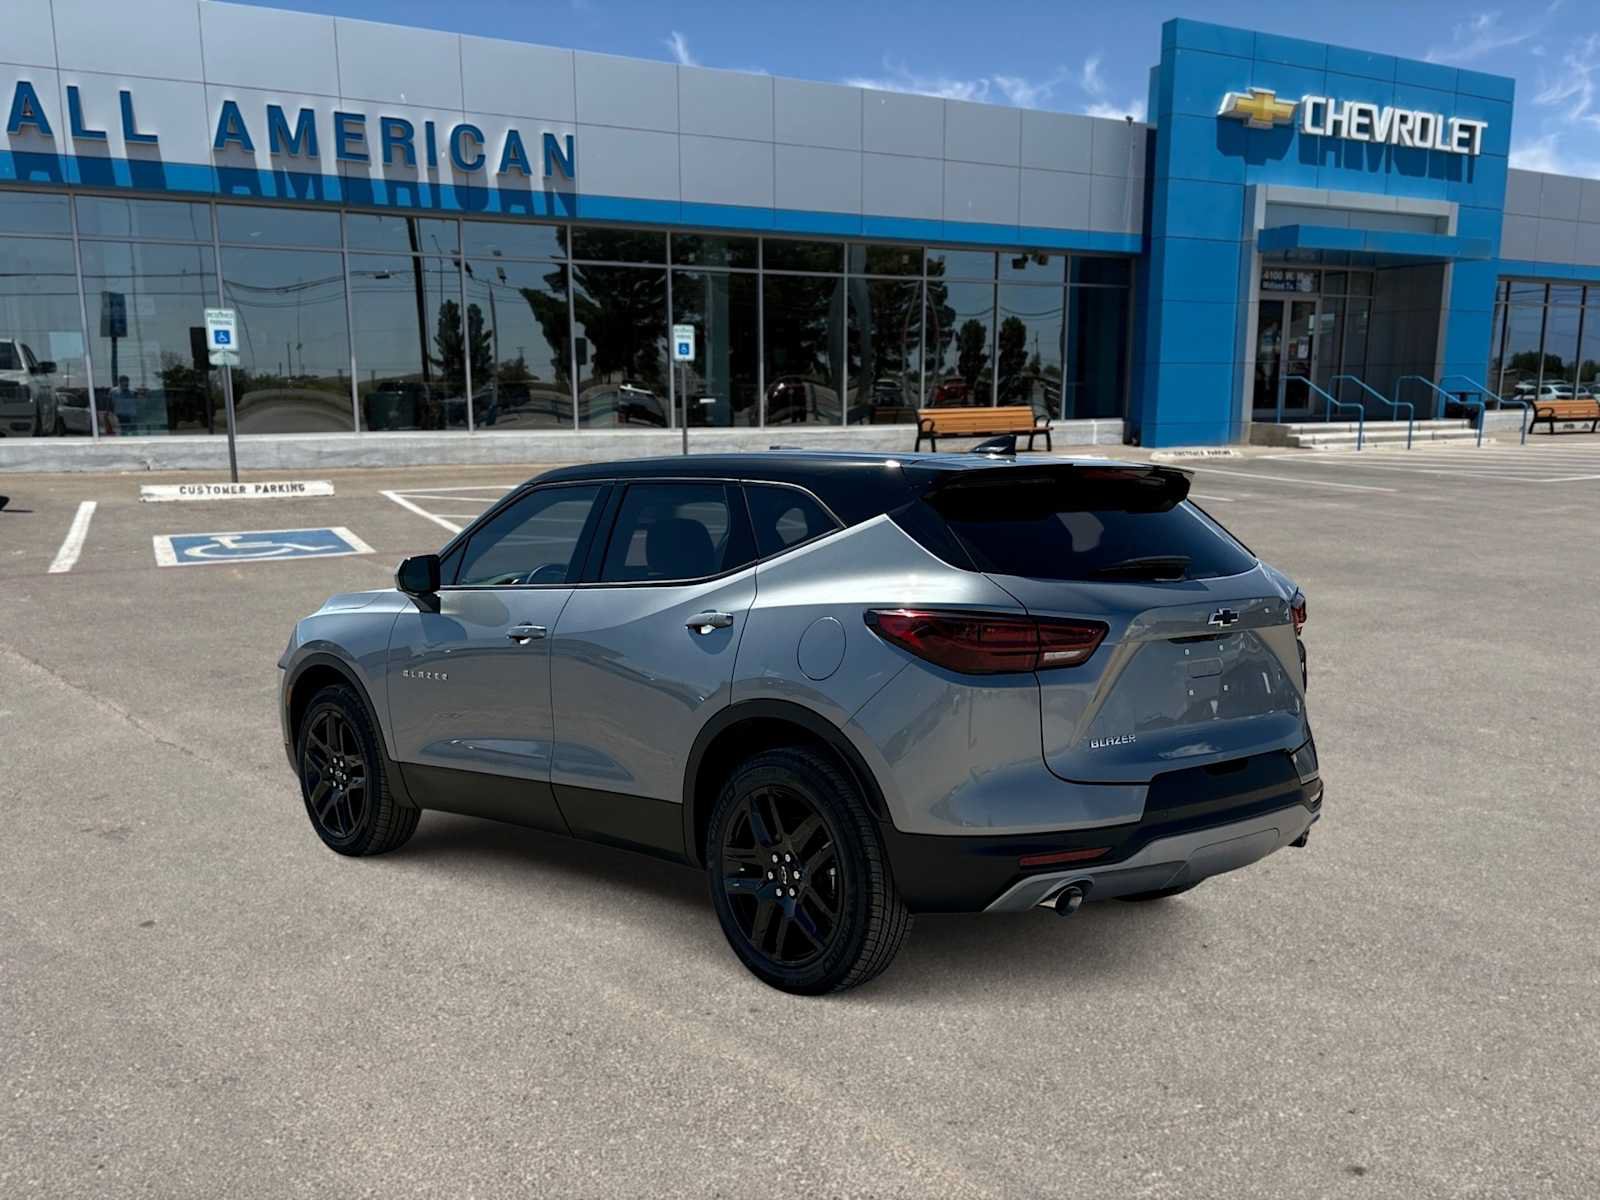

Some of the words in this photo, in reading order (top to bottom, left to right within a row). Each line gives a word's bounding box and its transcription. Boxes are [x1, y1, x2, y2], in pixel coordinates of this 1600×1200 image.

[6, 80, 159, 144] ALL
[213, 99, 576, 179] AMERICAN
[1301, 94, 1488, 156] CHEVROLET
[179, 485, 246, 495] CUSTOMER
[254, 483, 305, 493] PARKING
[1090, 734, 1137, 749] BLAZER
